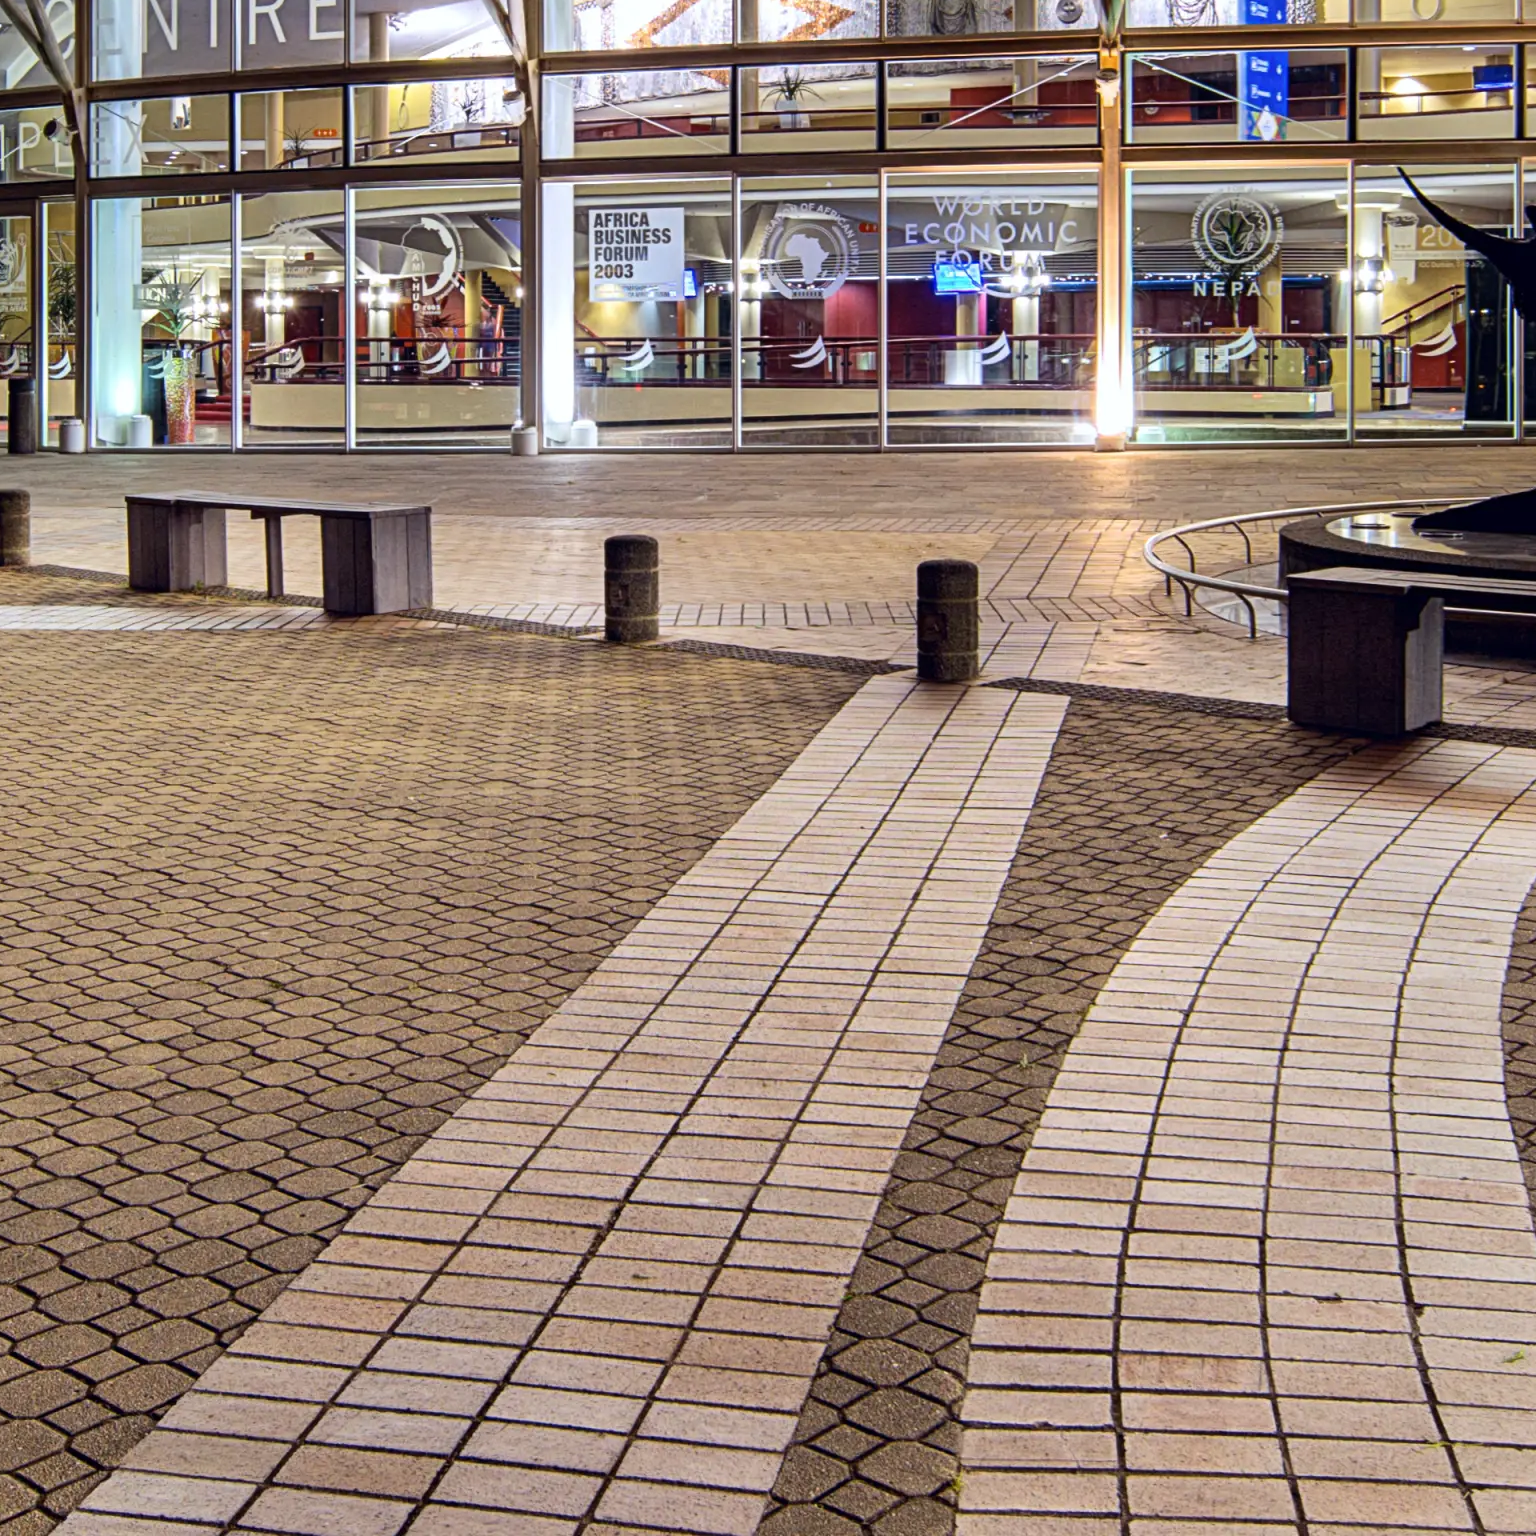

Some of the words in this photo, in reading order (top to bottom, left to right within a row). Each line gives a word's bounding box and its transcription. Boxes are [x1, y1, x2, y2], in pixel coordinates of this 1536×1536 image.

[800, 203, 815, 213] OF
[932, 195, 1046, 216] WORLD
[594, 212, 650, 228] AFRICA
[594, 228, 672, 245] BUSINESS
[905, 220, 1078, 245] ECONOMIC
[594, 246, 648, 262] FORUM
[935, 250, 1046, 272] FORUM
[594, 263, 634, 279] 2003
[1193, 280, 1279, 297] NEPAD
